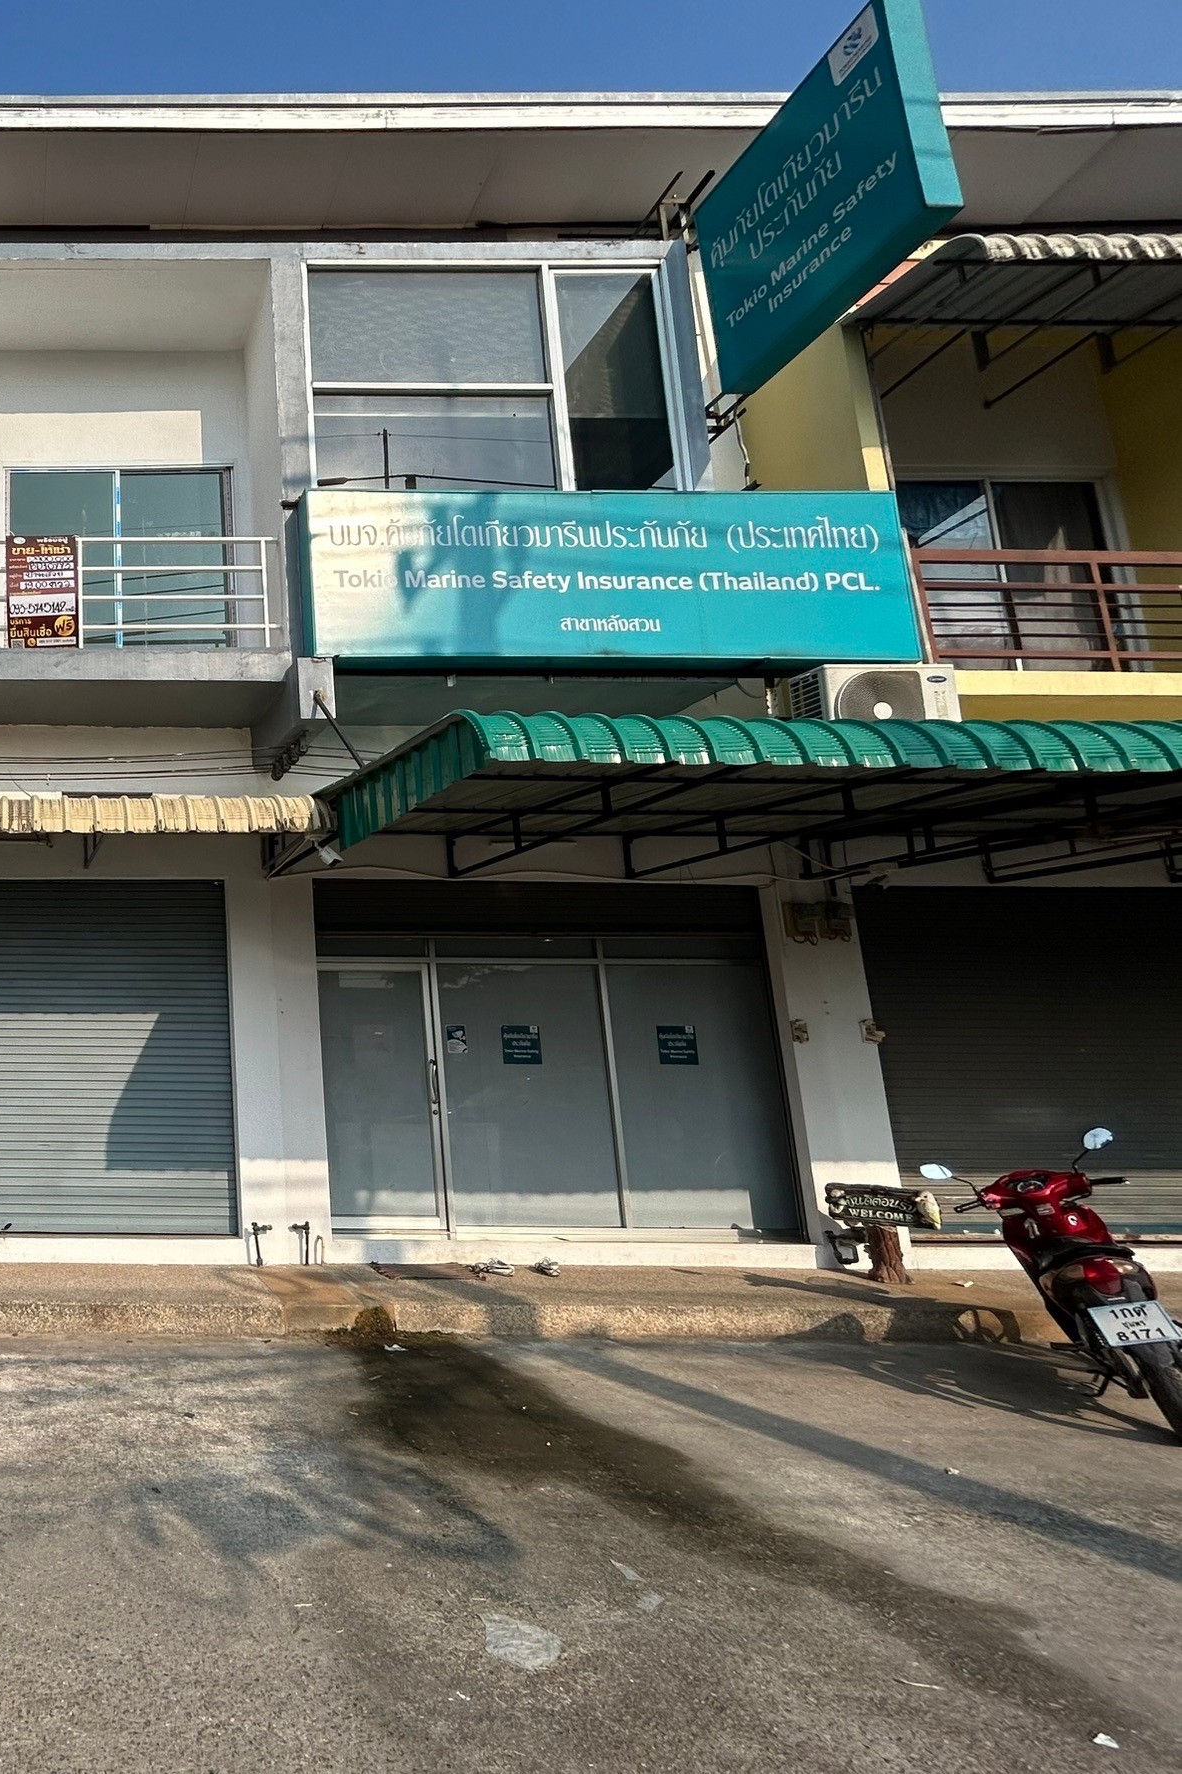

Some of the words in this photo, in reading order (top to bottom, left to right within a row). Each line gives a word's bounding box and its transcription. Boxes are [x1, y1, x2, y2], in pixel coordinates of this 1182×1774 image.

[748, 151, 843, 260] ประกันภัย
[726, 284, 768, 328] Tokio
[770, 223, 829, 286] Marine
[832, 150, 897, 224] Safety
[768, 226, 852, 313] Insurance
[727, 515, 880, 553] (ประเทศไทย)
[333, 569, 398, 589] Tokio
[404, 569, 486, 589] Marine
[492, 570, 570, 593] Safety
[577, 570, 693, 591] Insurance
[699, 571, 819, 592] (Thailand)
[825, 571, 881, 591] PCL.
[560, 613, 661, 633] สาขาหลังสวน
[848, 1208, 914, 1222] WELCOME
[1116, 1327, 1166, 1342] 8171
